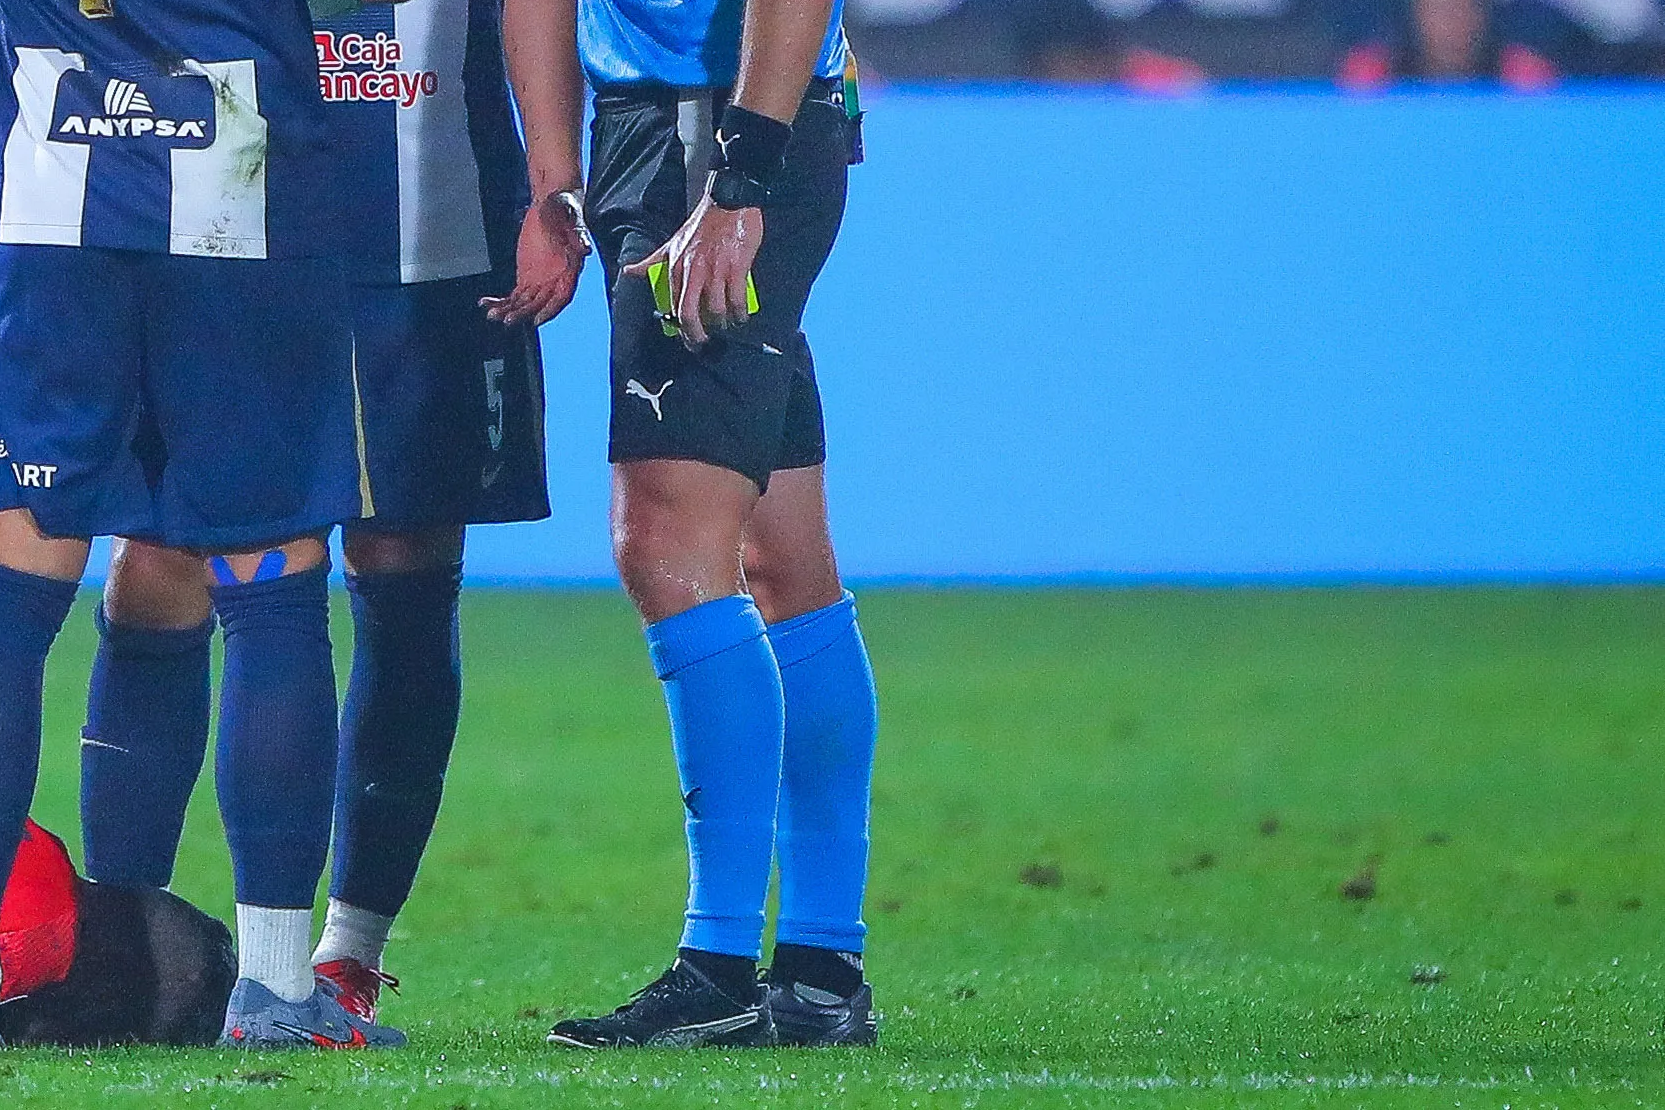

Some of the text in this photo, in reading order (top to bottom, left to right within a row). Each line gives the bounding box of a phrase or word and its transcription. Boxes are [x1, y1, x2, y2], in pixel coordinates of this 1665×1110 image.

[339, 32, 402, 70] Caja
[319, 71, 439, 109] ancayo
[59, 115, 205, 138] ANYPSA
